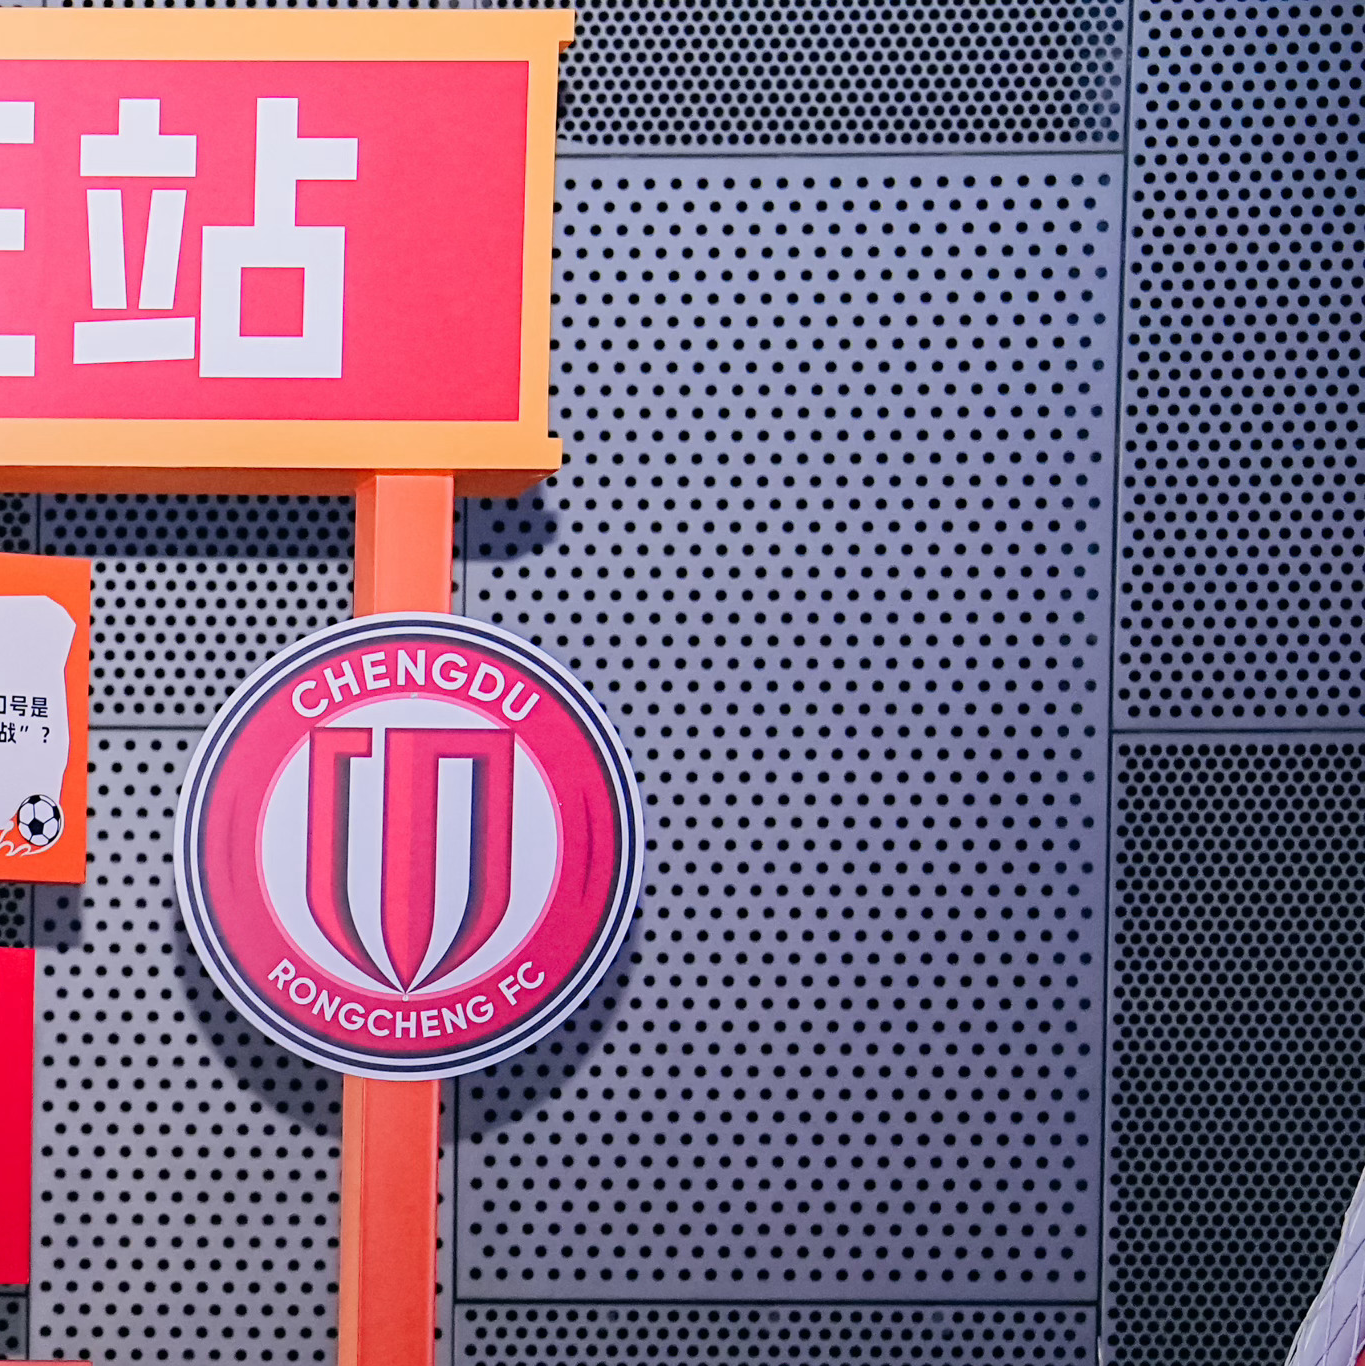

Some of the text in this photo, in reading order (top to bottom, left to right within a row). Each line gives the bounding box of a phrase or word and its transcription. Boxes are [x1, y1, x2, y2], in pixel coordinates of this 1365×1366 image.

[291, 648, 540, 721] CHENGDU
[268, 957, 546, 1039] RONGCHENG FC
